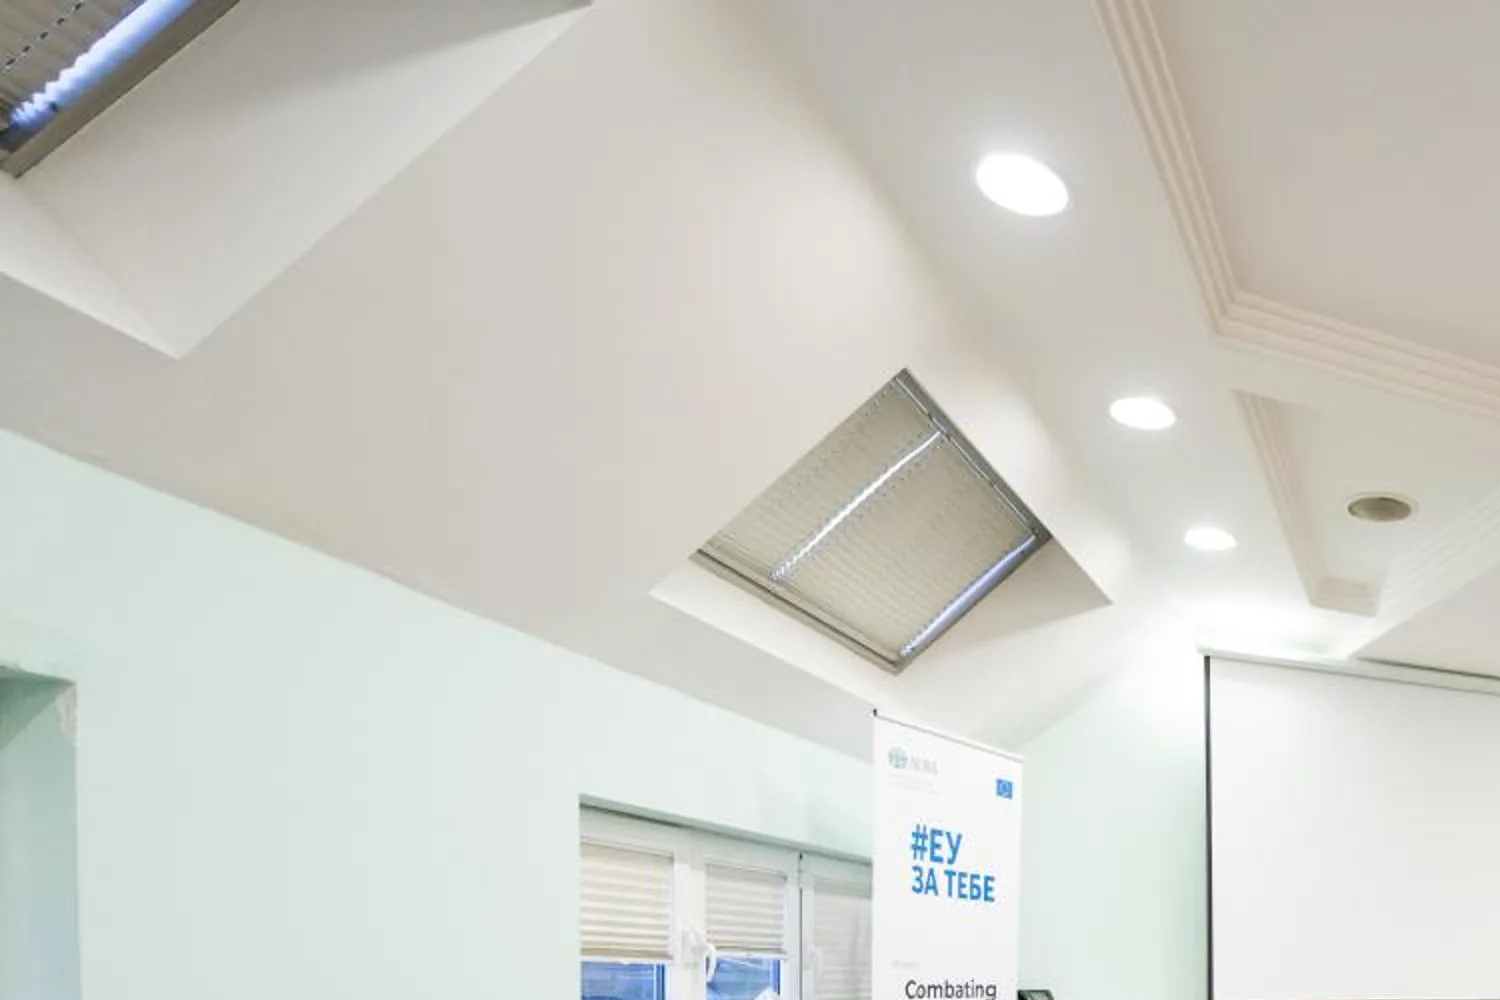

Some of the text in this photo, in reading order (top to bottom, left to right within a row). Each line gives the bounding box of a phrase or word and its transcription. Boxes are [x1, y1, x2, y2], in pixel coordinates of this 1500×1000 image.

[910, 824, 962, 864] #ЕУ
[911, 865, 995, 902] ЗА ТЕБЕ
